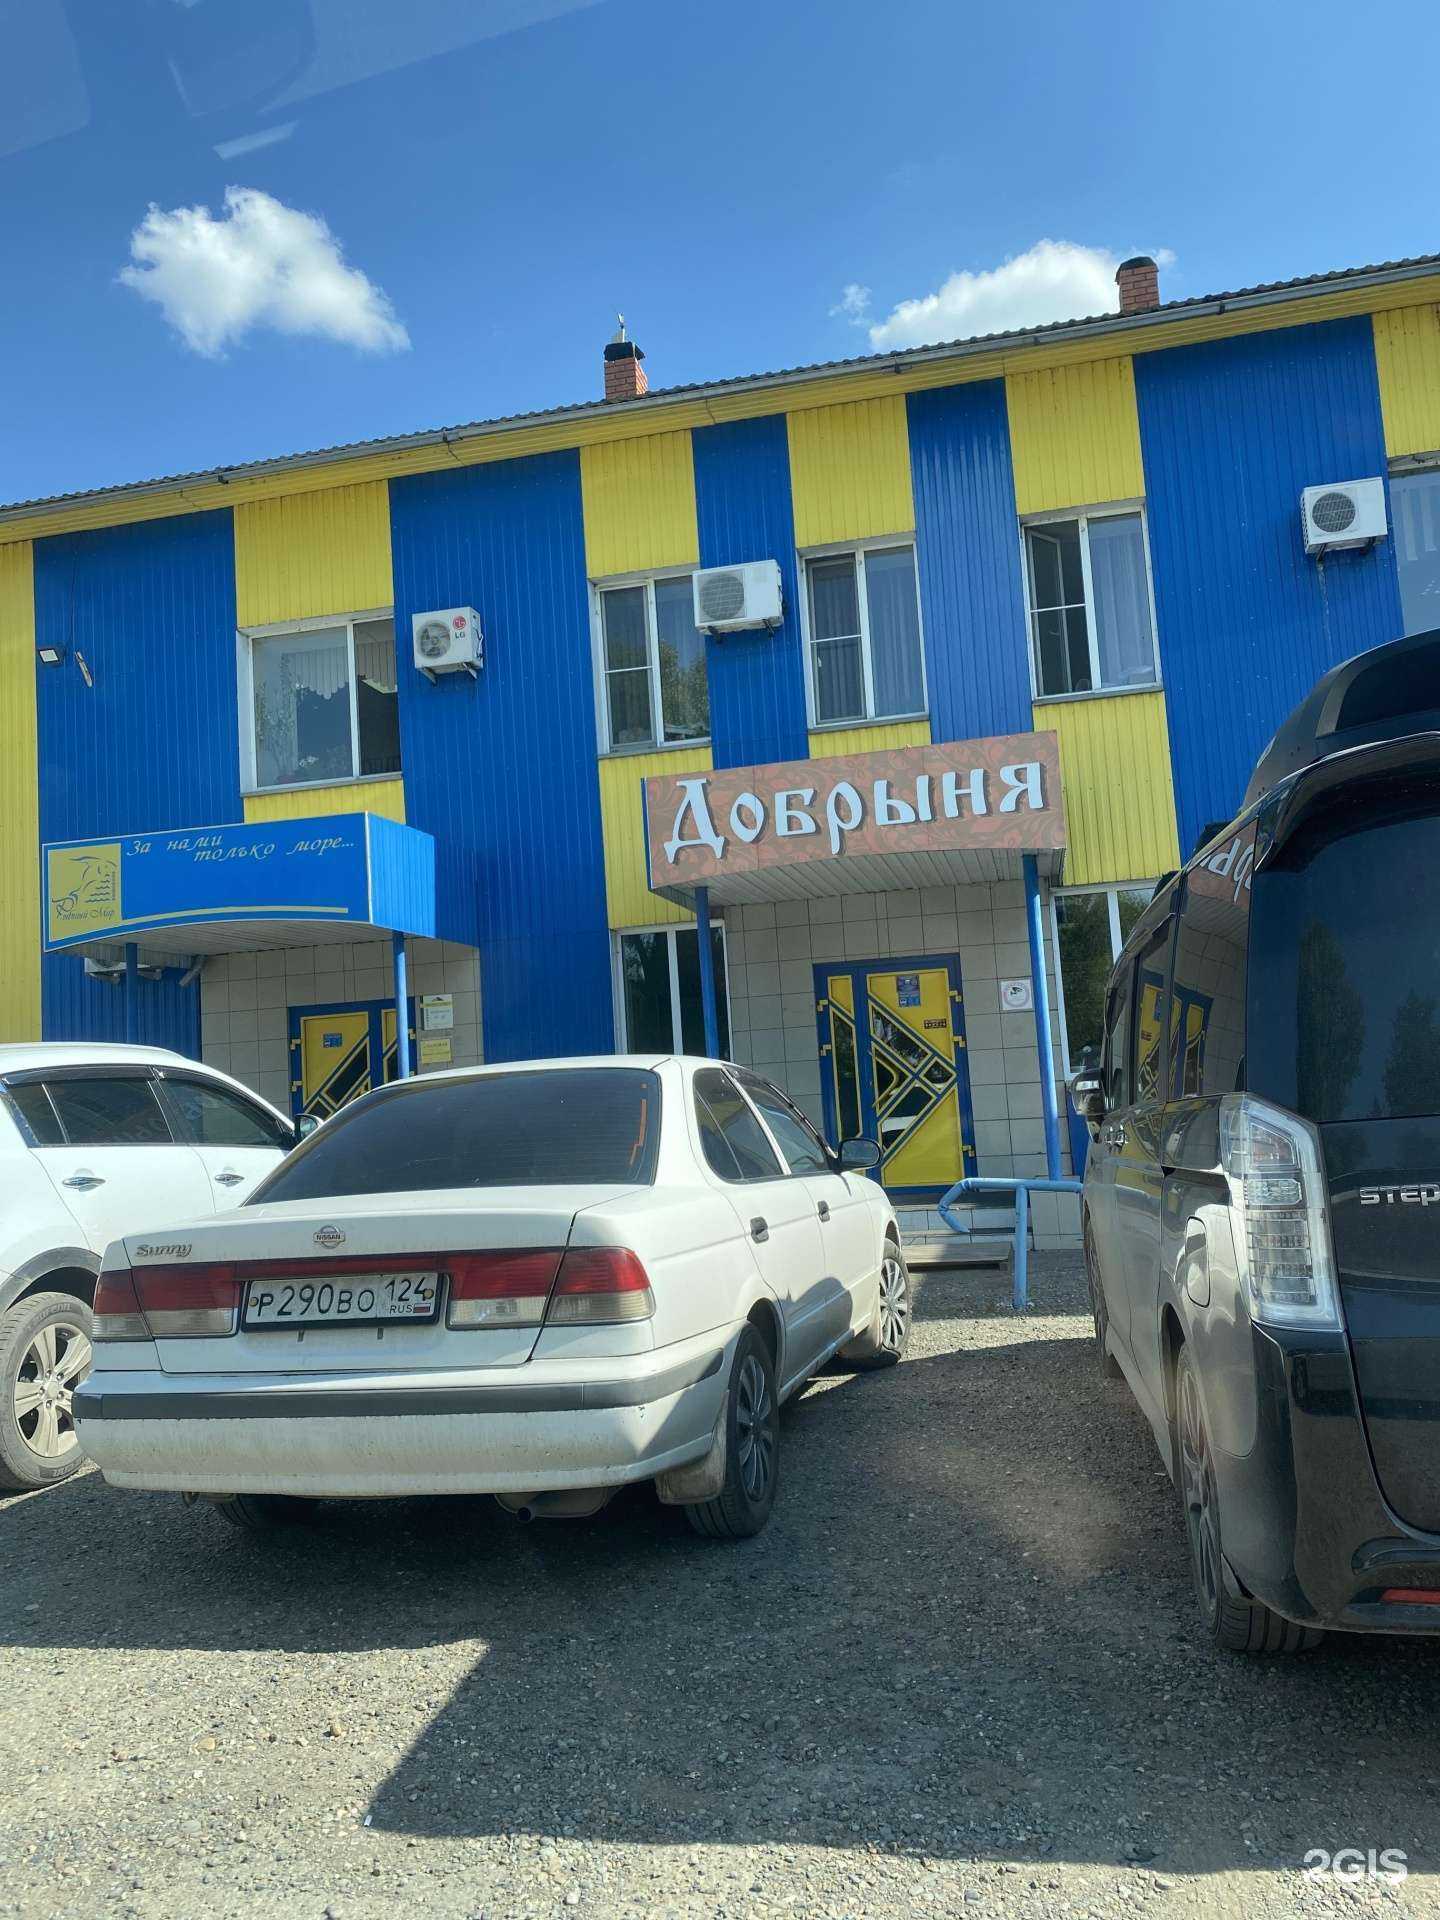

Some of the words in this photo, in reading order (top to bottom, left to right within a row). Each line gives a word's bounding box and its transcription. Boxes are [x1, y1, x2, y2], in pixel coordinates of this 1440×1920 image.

[126, 840, 151, 856] За
[167, 835, 223, 851] нами
[194, 843, 275, 861] только
[315, 1233, 342, 1241] NISSAN
[136, 1244, 192, 1258] Sunny
[384, 1276, 434, 1302] 124
[389, 1304, 413, 1315] RUS
